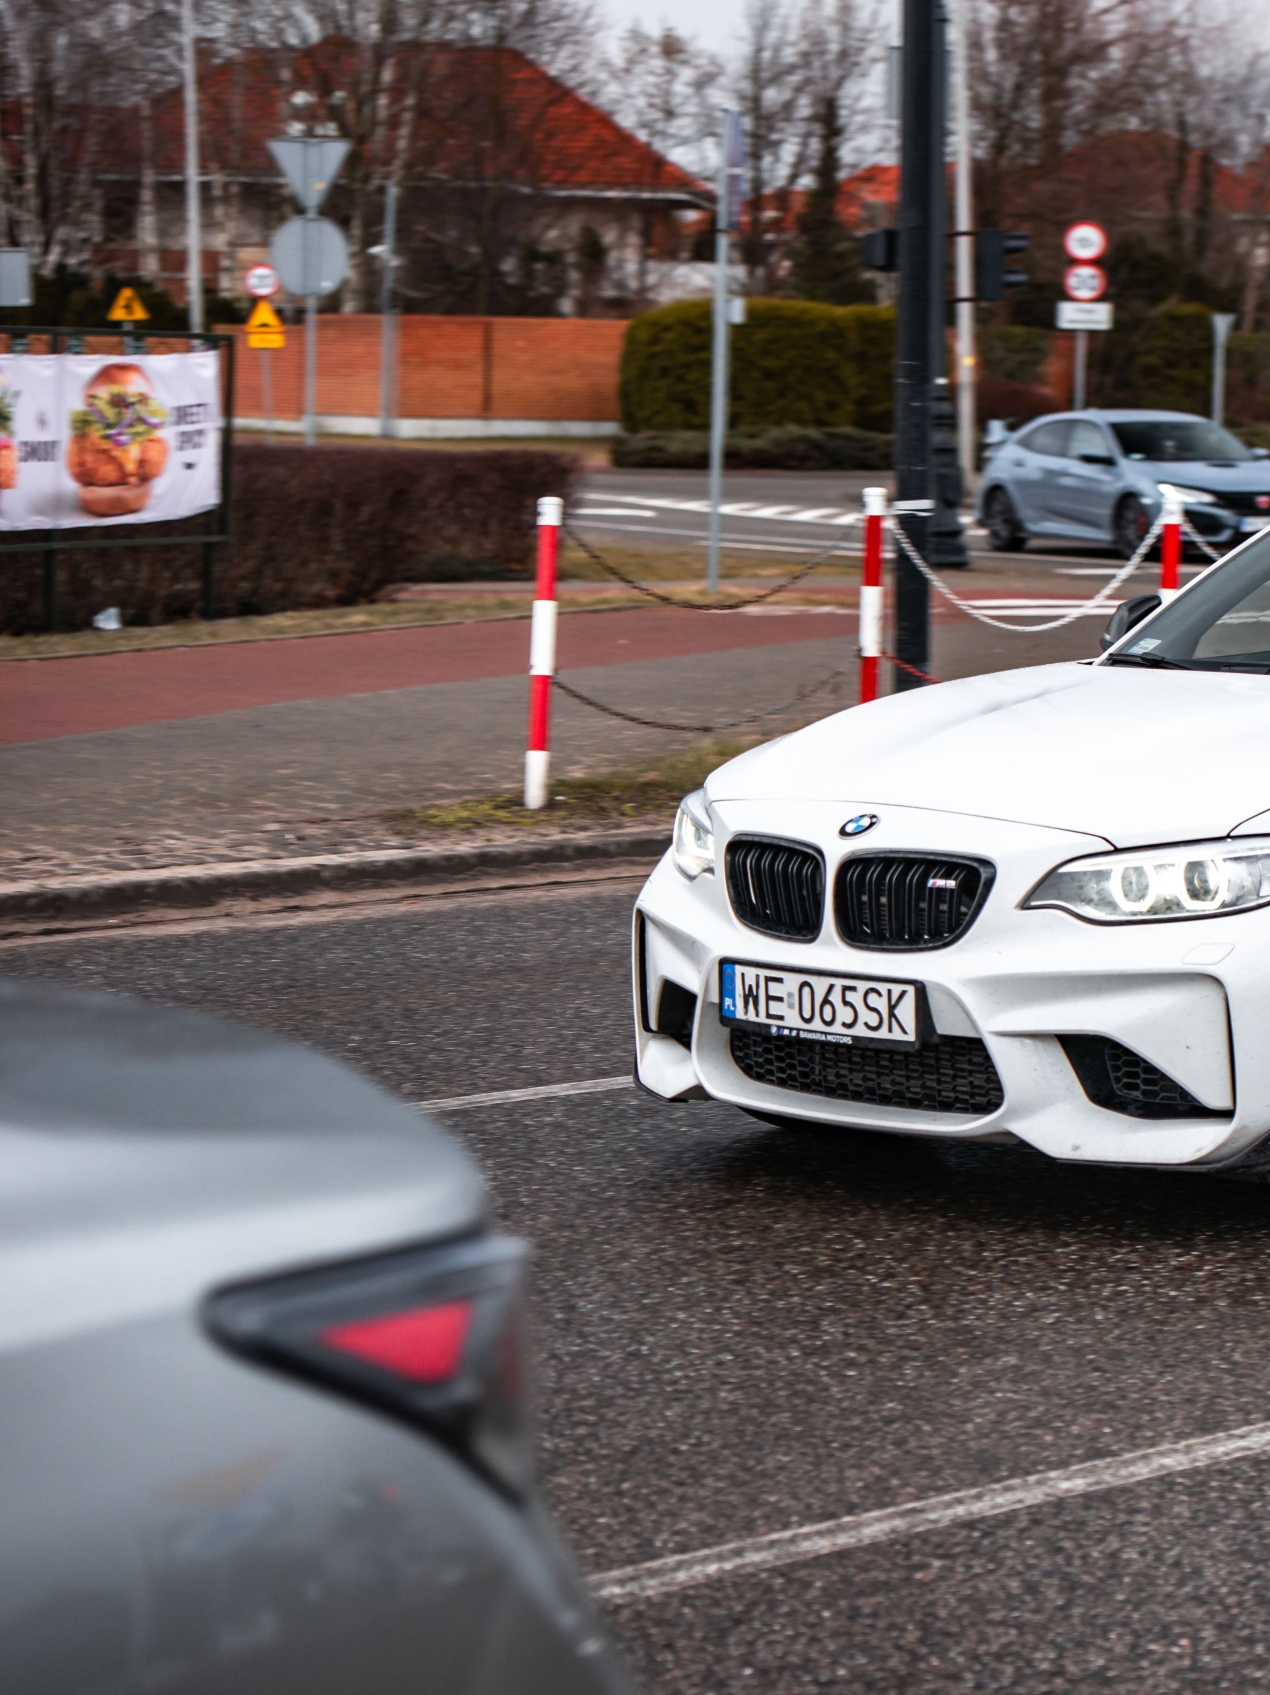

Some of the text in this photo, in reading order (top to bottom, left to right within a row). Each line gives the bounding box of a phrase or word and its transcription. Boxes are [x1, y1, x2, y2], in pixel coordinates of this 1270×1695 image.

[724, 997, 735, 1011] PL
[740, 971, 910, 1036] WE 065SK
[826, 1034, 853, 1045] MOTORS
